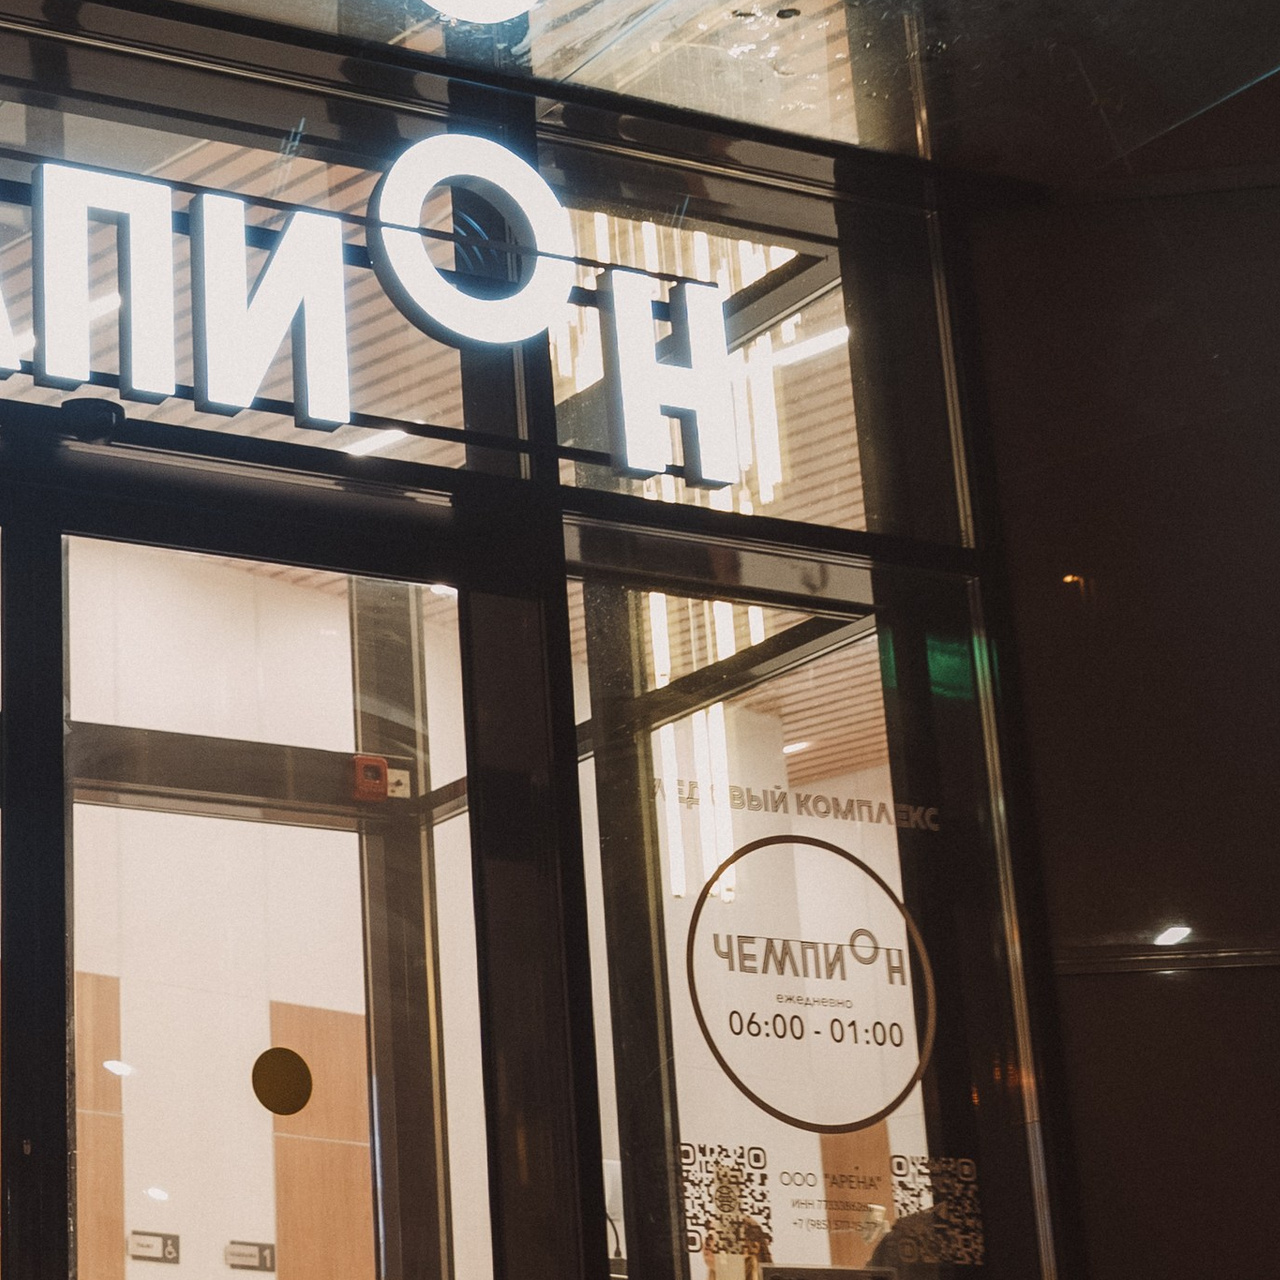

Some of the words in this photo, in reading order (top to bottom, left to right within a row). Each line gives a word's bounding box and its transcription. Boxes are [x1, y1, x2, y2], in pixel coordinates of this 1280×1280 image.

[794, 791, 941, 832] КОМПЛЕКС
[713, 928, 907, 986] ЧЕМПИОН
[776, 992, 854, 1009] ежедневно
[729, 1010, 804, 1040] 06:00
[830, 1018, 904, 1047] 01:00
[780, 1171, 817, 1187] ООО
